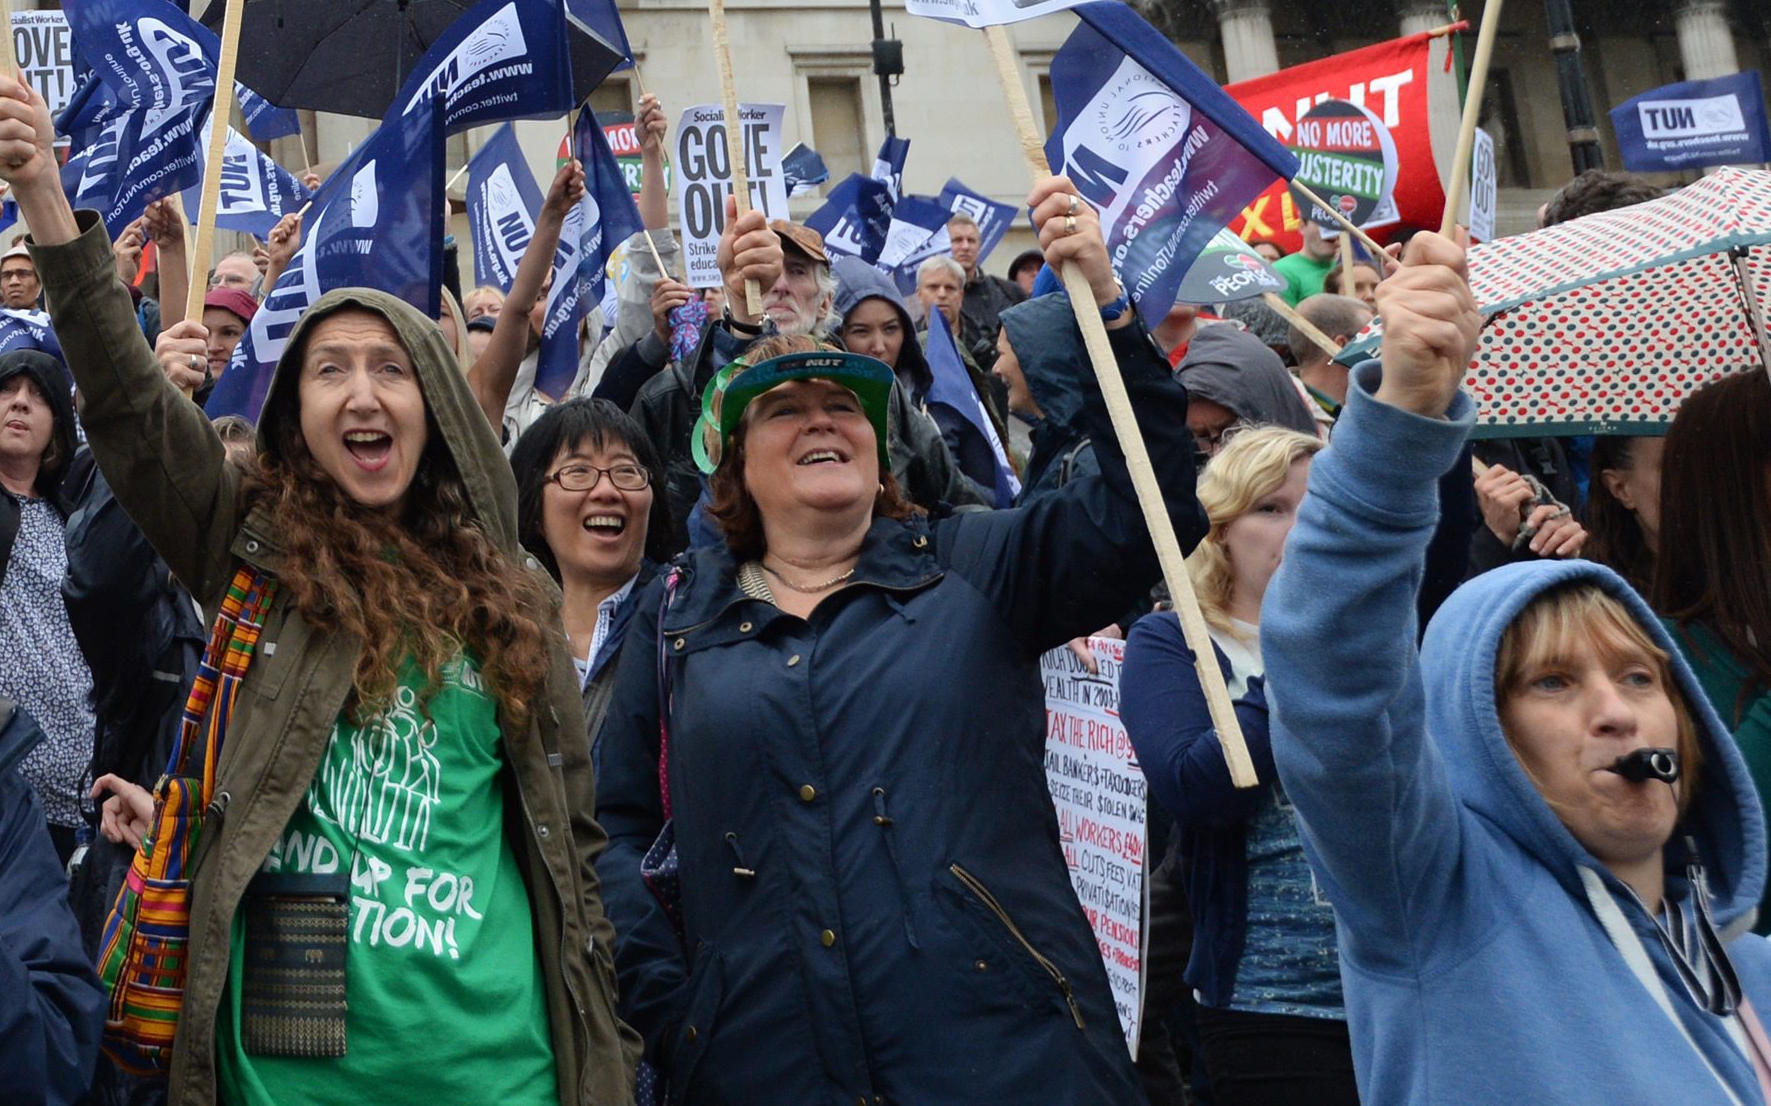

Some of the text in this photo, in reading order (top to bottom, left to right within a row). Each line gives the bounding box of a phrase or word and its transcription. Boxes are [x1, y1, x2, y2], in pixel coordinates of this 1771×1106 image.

[1297, 121, 1372, 148] NO MORE
[1294, 151, 1384, 195] USTERITY
[497, 211, 533, 266] NU
[689, 242, 716, 256] Strike
[805, 358, 842, 367] NUT
[1083, 685, 1091, 705] IN
[1044, 709, 1114, 755] TAX THE RICH
[1072, 787, 1093, 811] THEIR
[1060, 808, 1074, 837] ALL
[1076, 815, 1122, 854] WORKERS
[351, 850, 392, 897] UP
[406, 867, 483, 920] FOR
